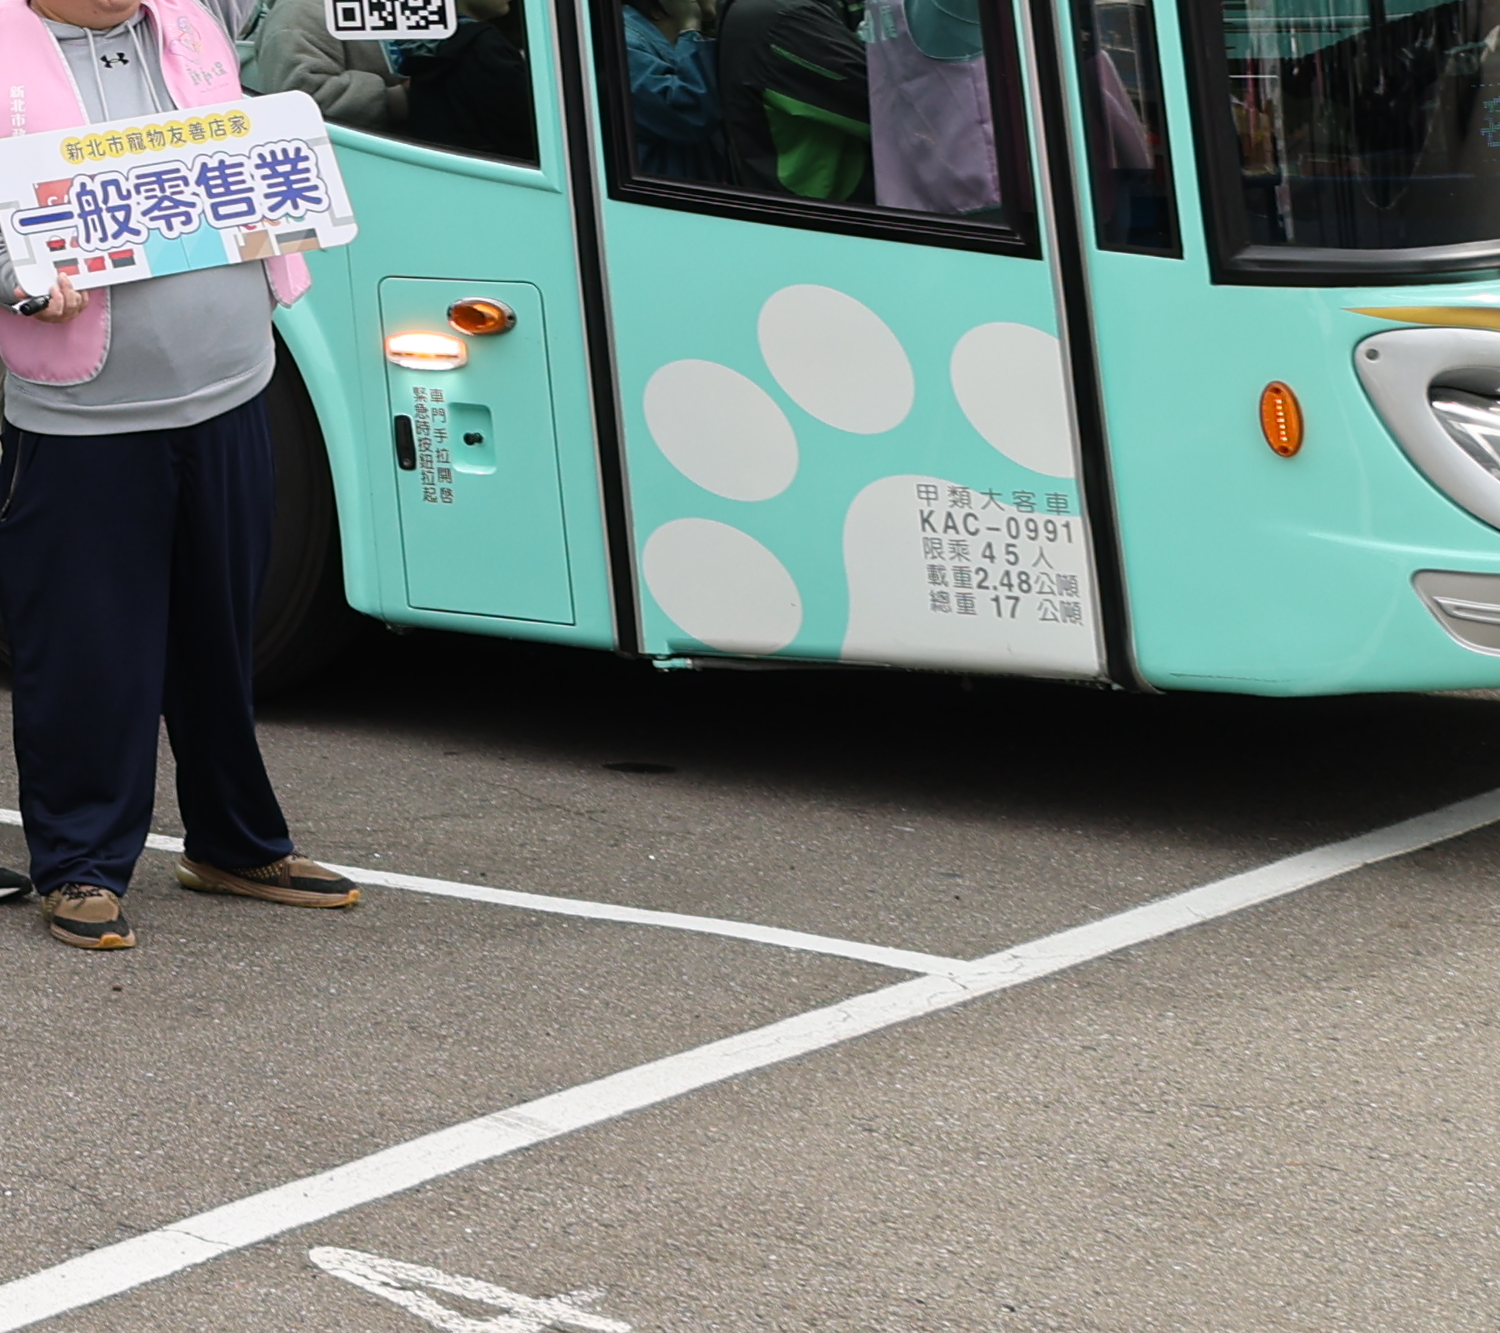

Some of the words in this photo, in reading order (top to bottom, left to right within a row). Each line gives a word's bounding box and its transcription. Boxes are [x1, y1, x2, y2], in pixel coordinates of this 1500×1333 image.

[64, 114, 250, 162] 新北市寵物友善店家
[18, 145, 323, 245] 一般零售業
[916, 483, 1071, 515] 甲類大客車
[919, 508, 1073, 544] KAC-0991
